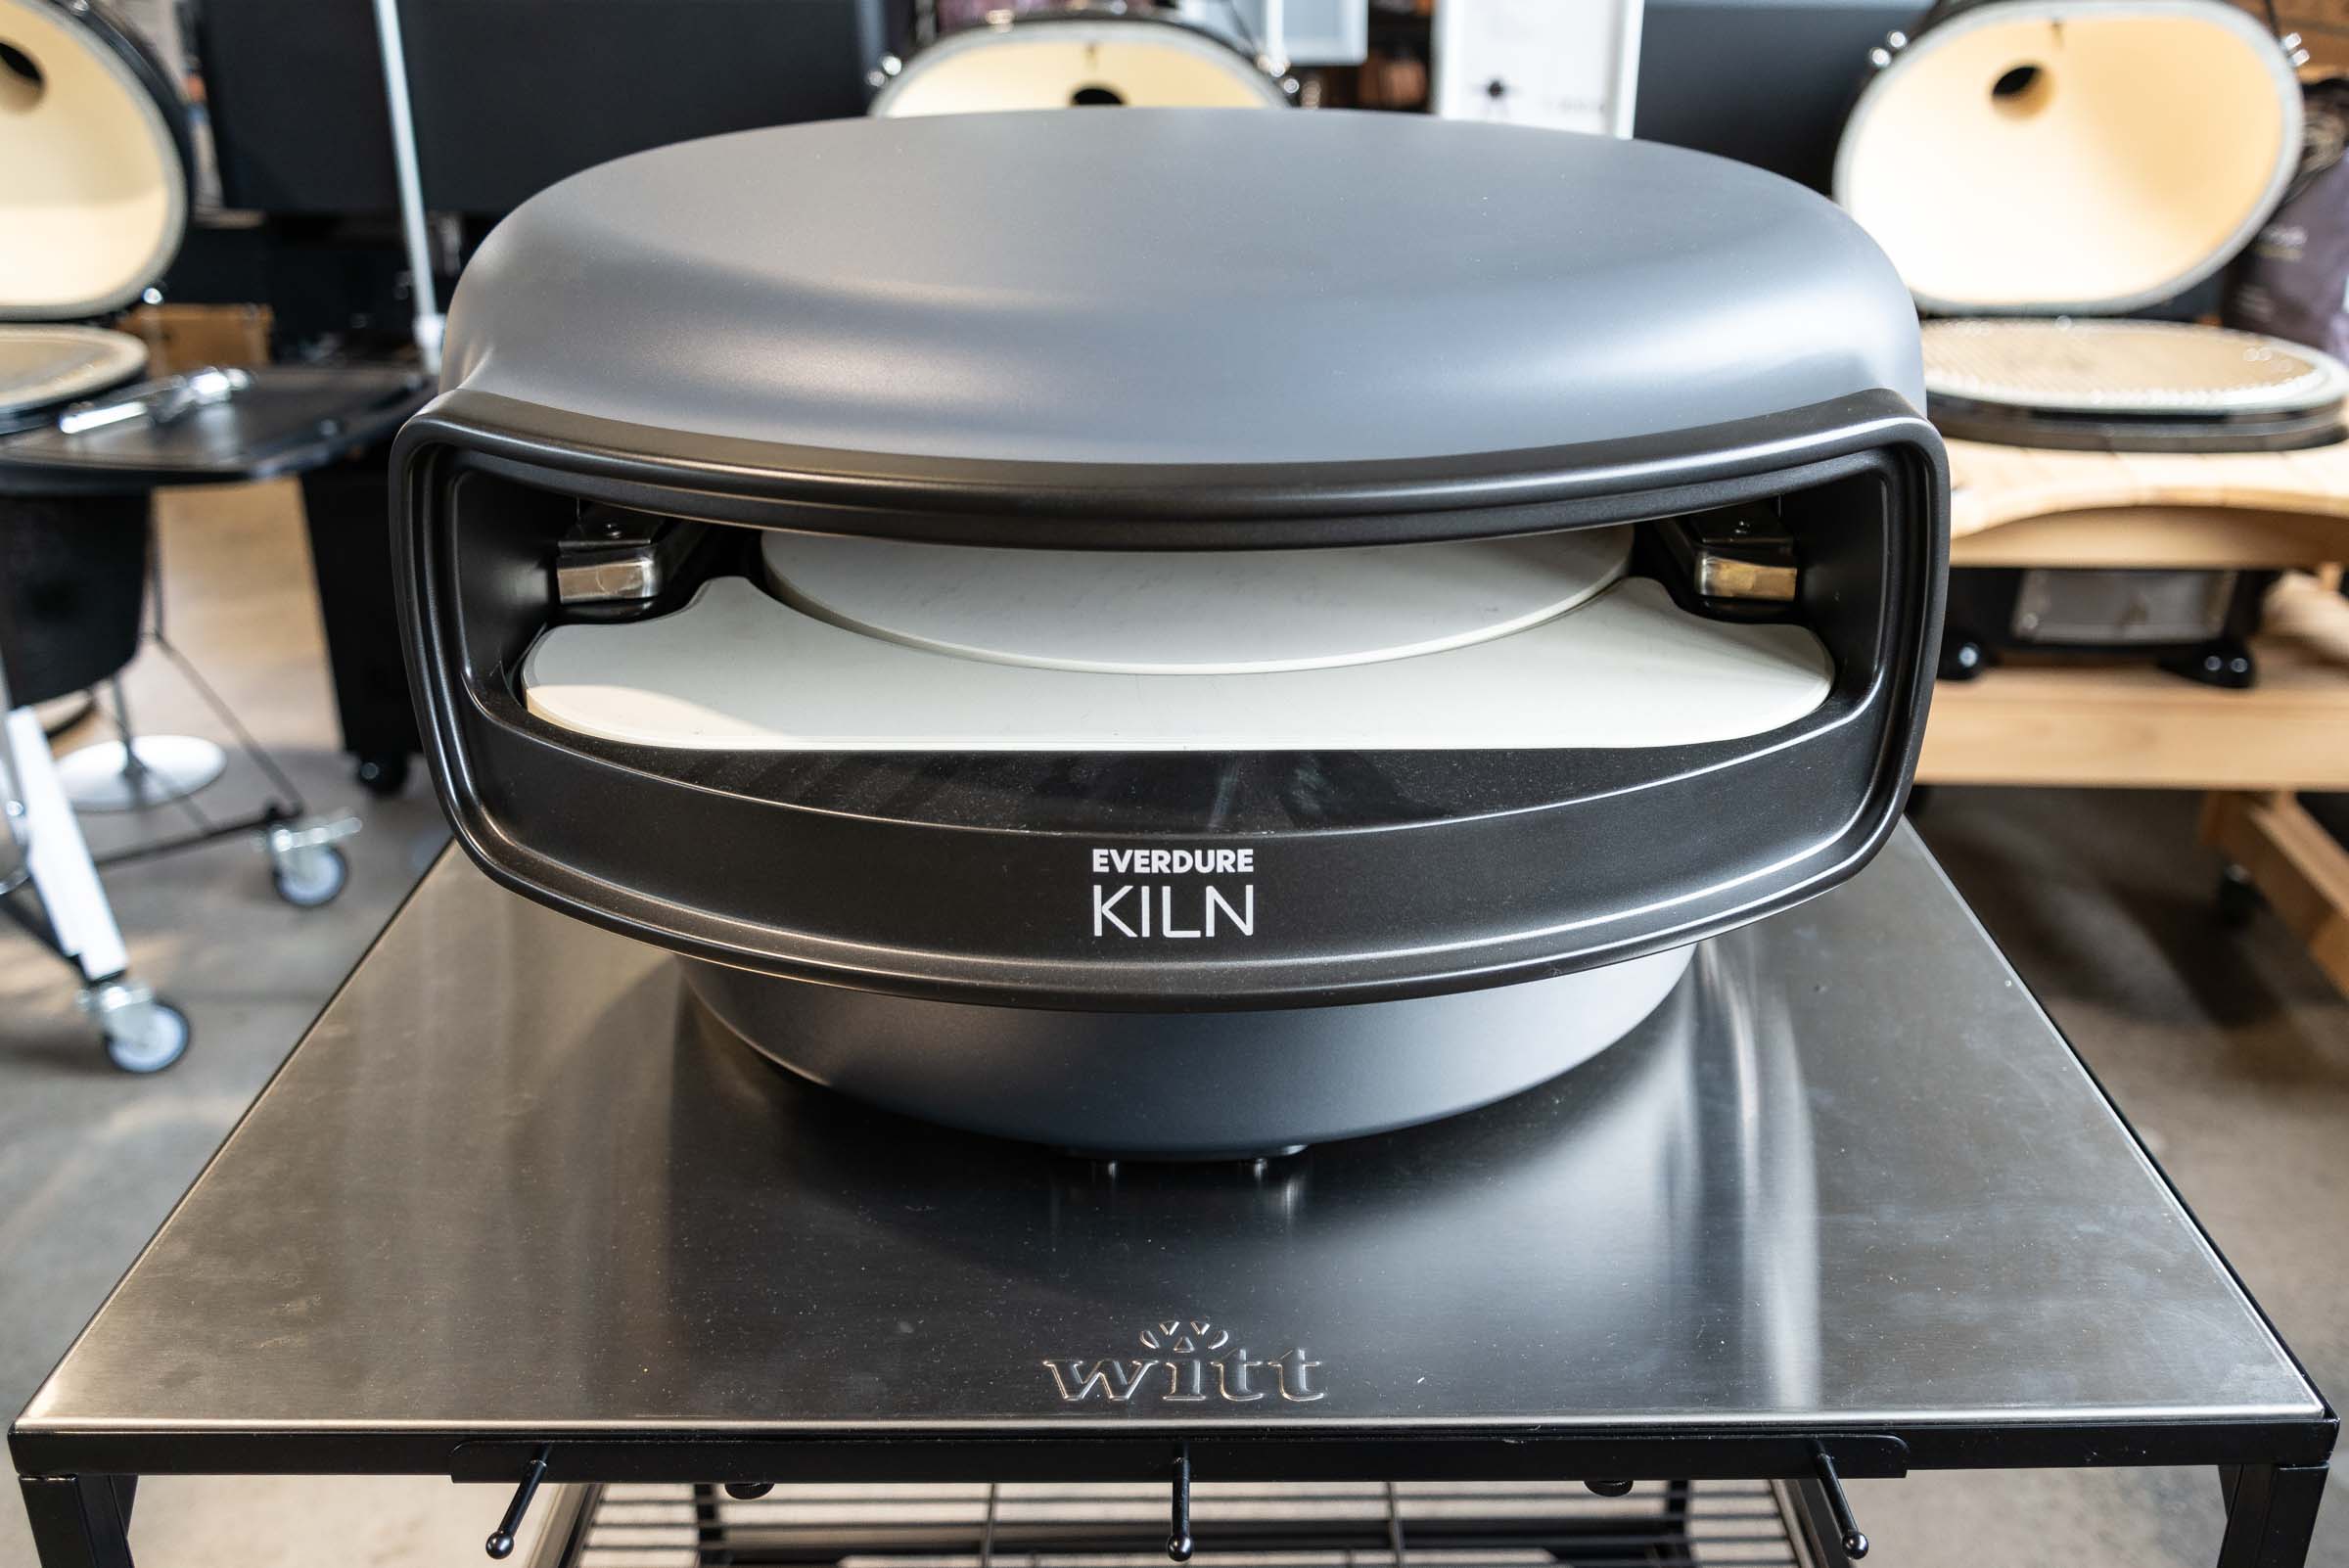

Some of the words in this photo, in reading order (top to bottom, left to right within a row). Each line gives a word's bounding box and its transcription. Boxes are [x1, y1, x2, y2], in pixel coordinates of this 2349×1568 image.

[1092, 849, 1254, 873] EVERDURE
[1092, 885, 1254, 938] KILN
[1042, 1335, 1325, 1402] witt
